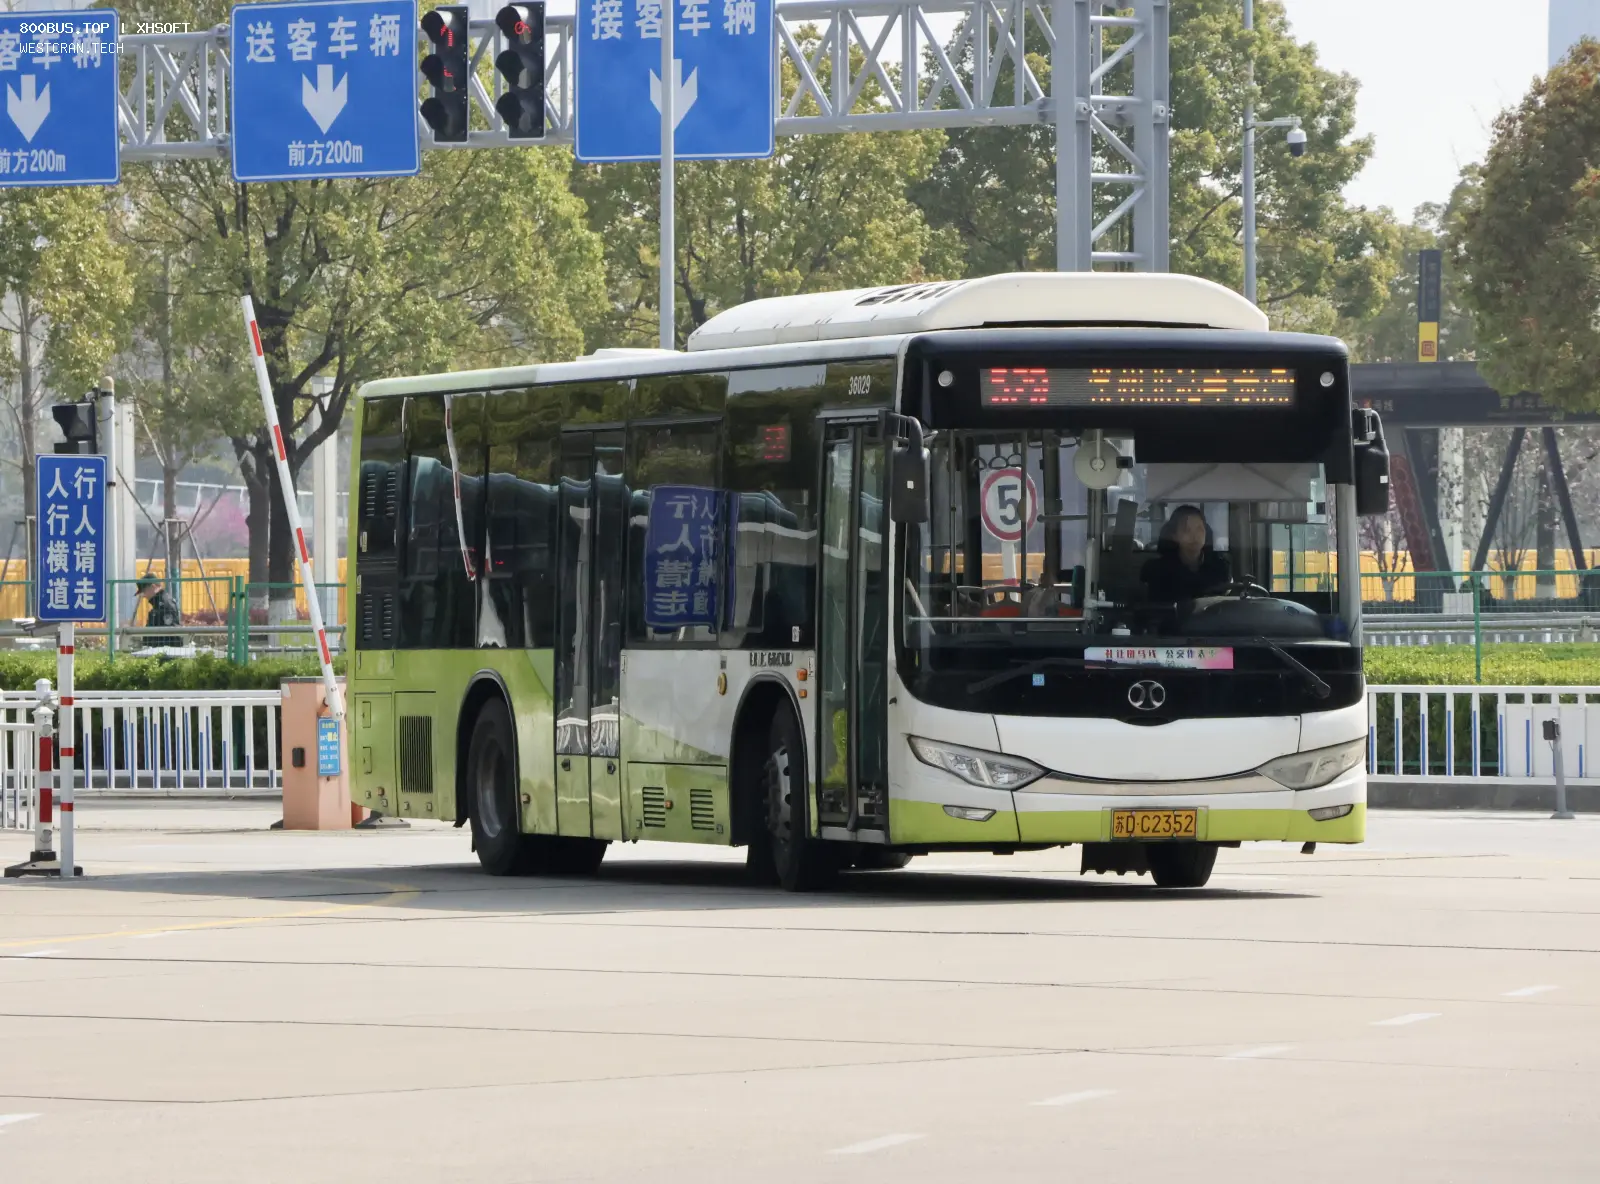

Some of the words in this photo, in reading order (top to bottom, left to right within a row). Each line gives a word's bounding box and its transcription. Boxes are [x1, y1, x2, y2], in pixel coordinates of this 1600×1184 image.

[246, 13, 401, 63] 送客车辆
[591, 0, 756, 40] 接客车辆
[288, 140, 363, 167] 前方200m
[848, 374, 871, 395] 36029
[997, 484, 1022, 526] 5
[46, 467, 70, 609] 人行横道
[74, 466, 97, 610] 行人请走
